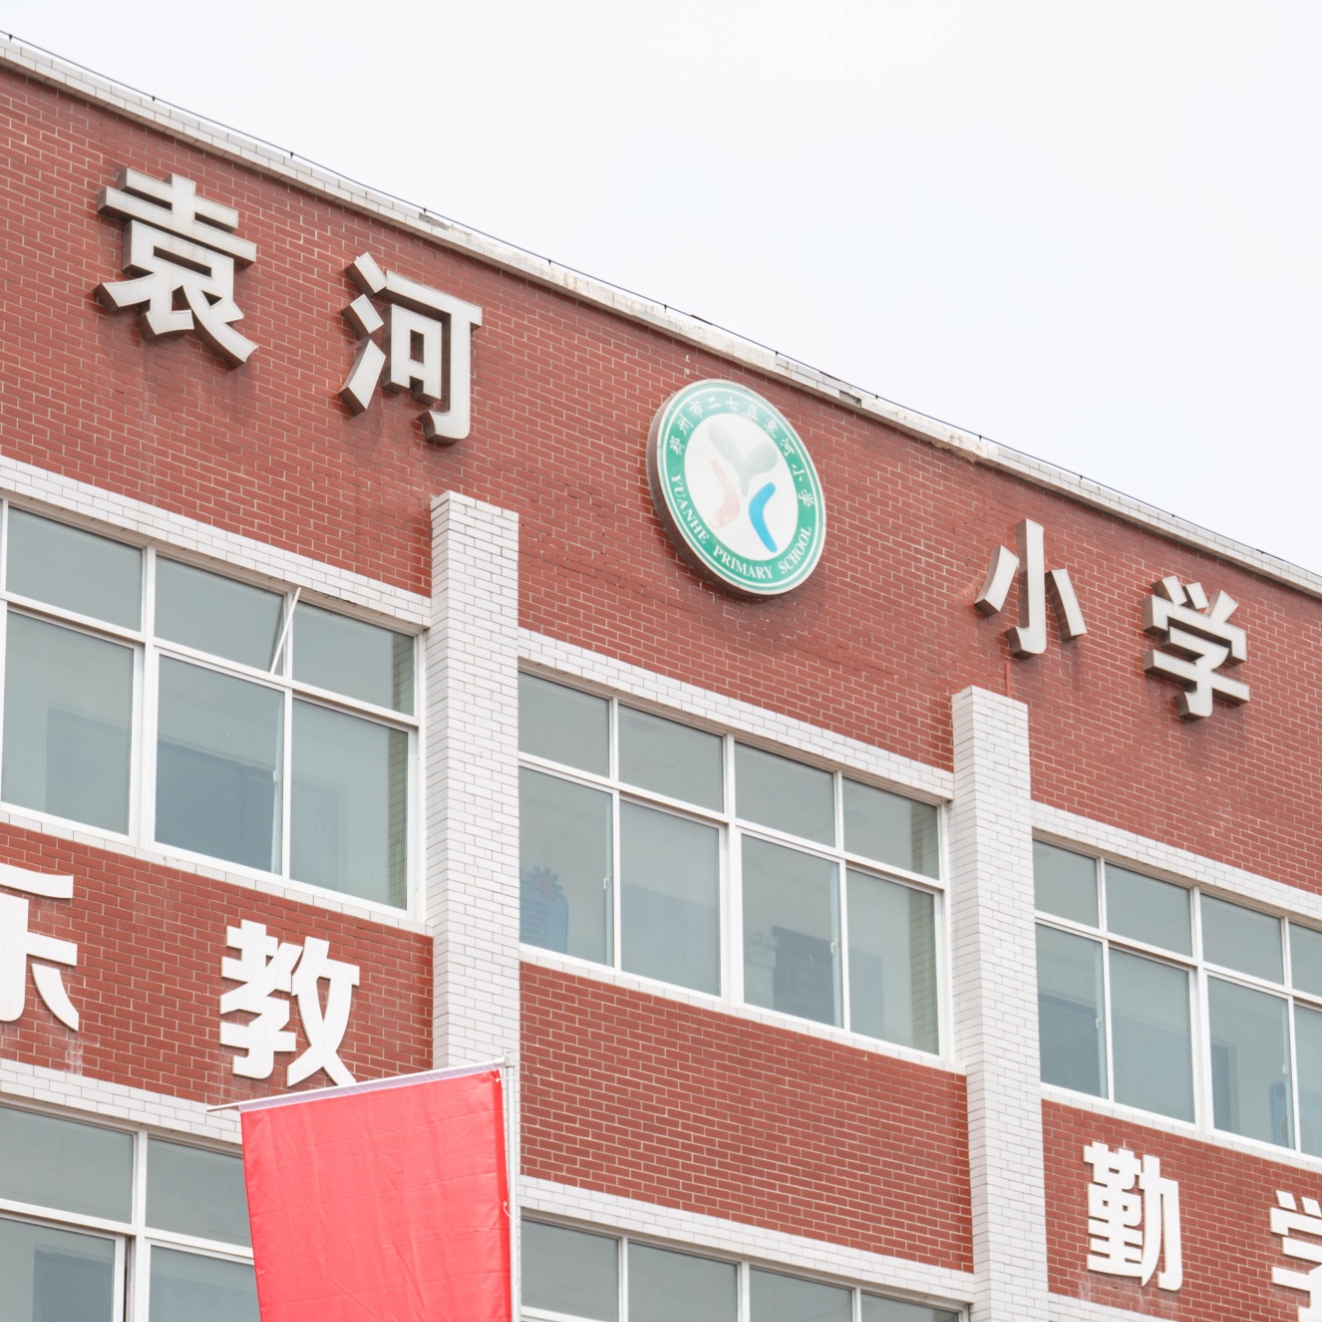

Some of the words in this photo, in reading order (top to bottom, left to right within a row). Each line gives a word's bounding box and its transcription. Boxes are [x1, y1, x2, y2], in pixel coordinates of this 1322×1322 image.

[95, 167, 481, 443] 袁河
[975, 519, 1251, 718] 小学
[670, 473, 710, 545] YUANHE
[714, 546, 773, 580] PRIMARY
[777, 526, 813, 575] SCHOOL
